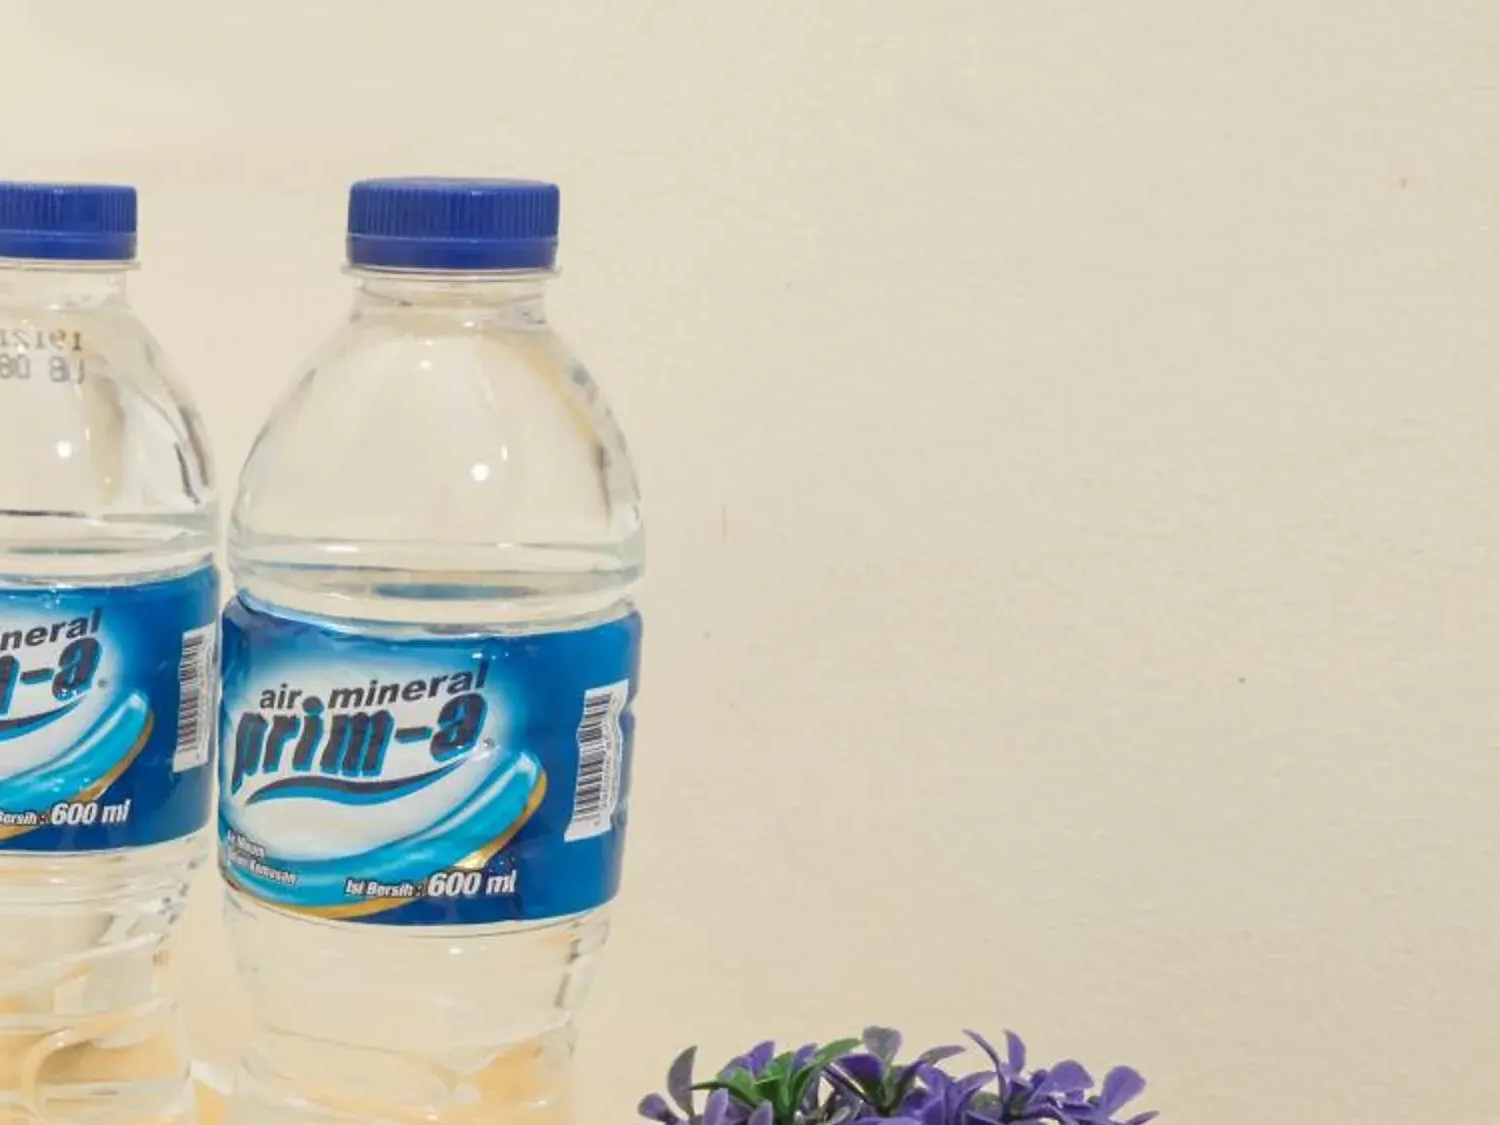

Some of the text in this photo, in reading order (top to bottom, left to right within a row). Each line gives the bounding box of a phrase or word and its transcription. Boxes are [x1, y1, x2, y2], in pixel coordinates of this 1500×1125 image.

[259, 656, 490, 710] air mineral
[231, 692, 489, 797] prim-a
[50, 801, 99, 826] 600
[102, 798, 132, 824] ml
[427, 871, 483, 897] 600
[485, 869, 517, 895] ml
